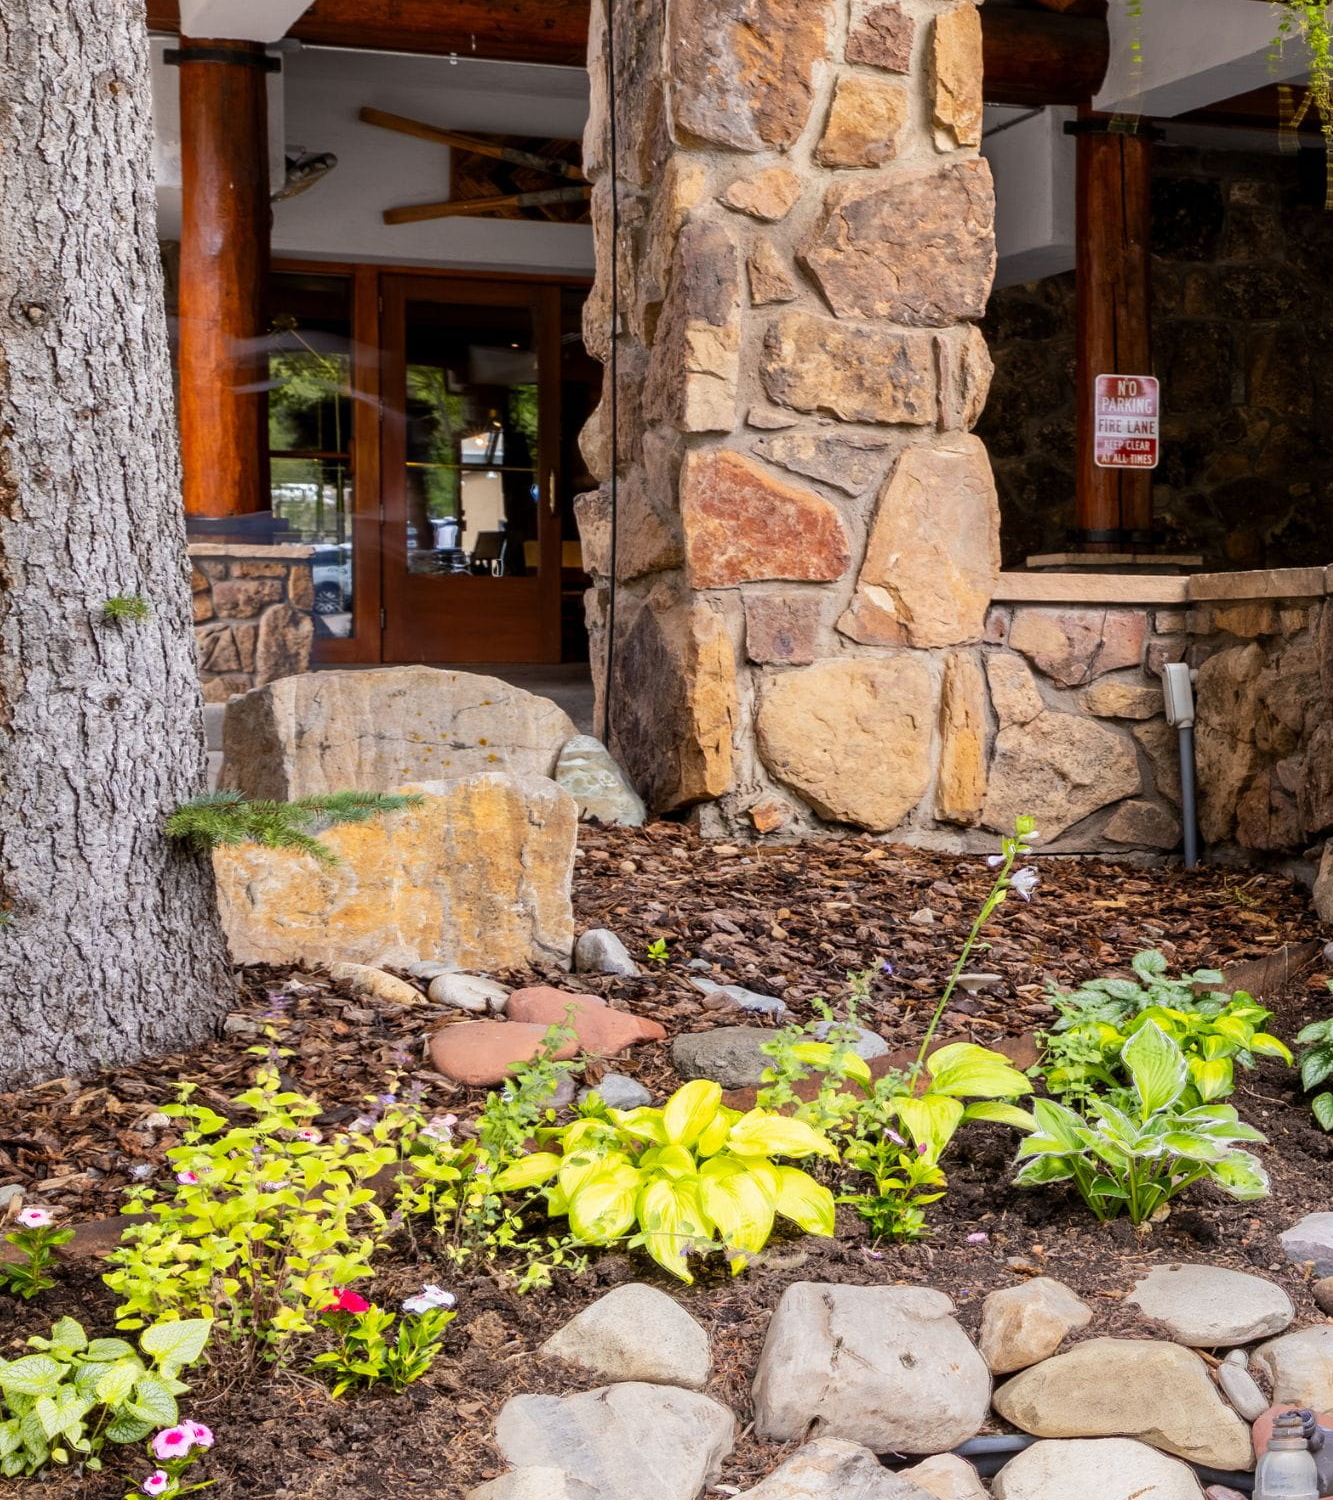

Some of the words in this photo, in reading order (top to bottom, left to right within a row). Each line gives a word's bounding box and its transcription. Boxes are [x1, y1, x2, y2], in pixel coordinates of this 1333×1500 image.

[1118, 380, 1137, 396] NO
[1102, 397, 1153, 414] PARKING
[1098, 419, 1122, 433] FIRE
[1127, 420, 1156, 435] LANE
[1126, 440, 1151, 451] CLEAR
[1101, 453, 1111, 463] AT
[1112, 453, 1127, 464] ALL
[1130, 454, 1153, 465] TIMES
